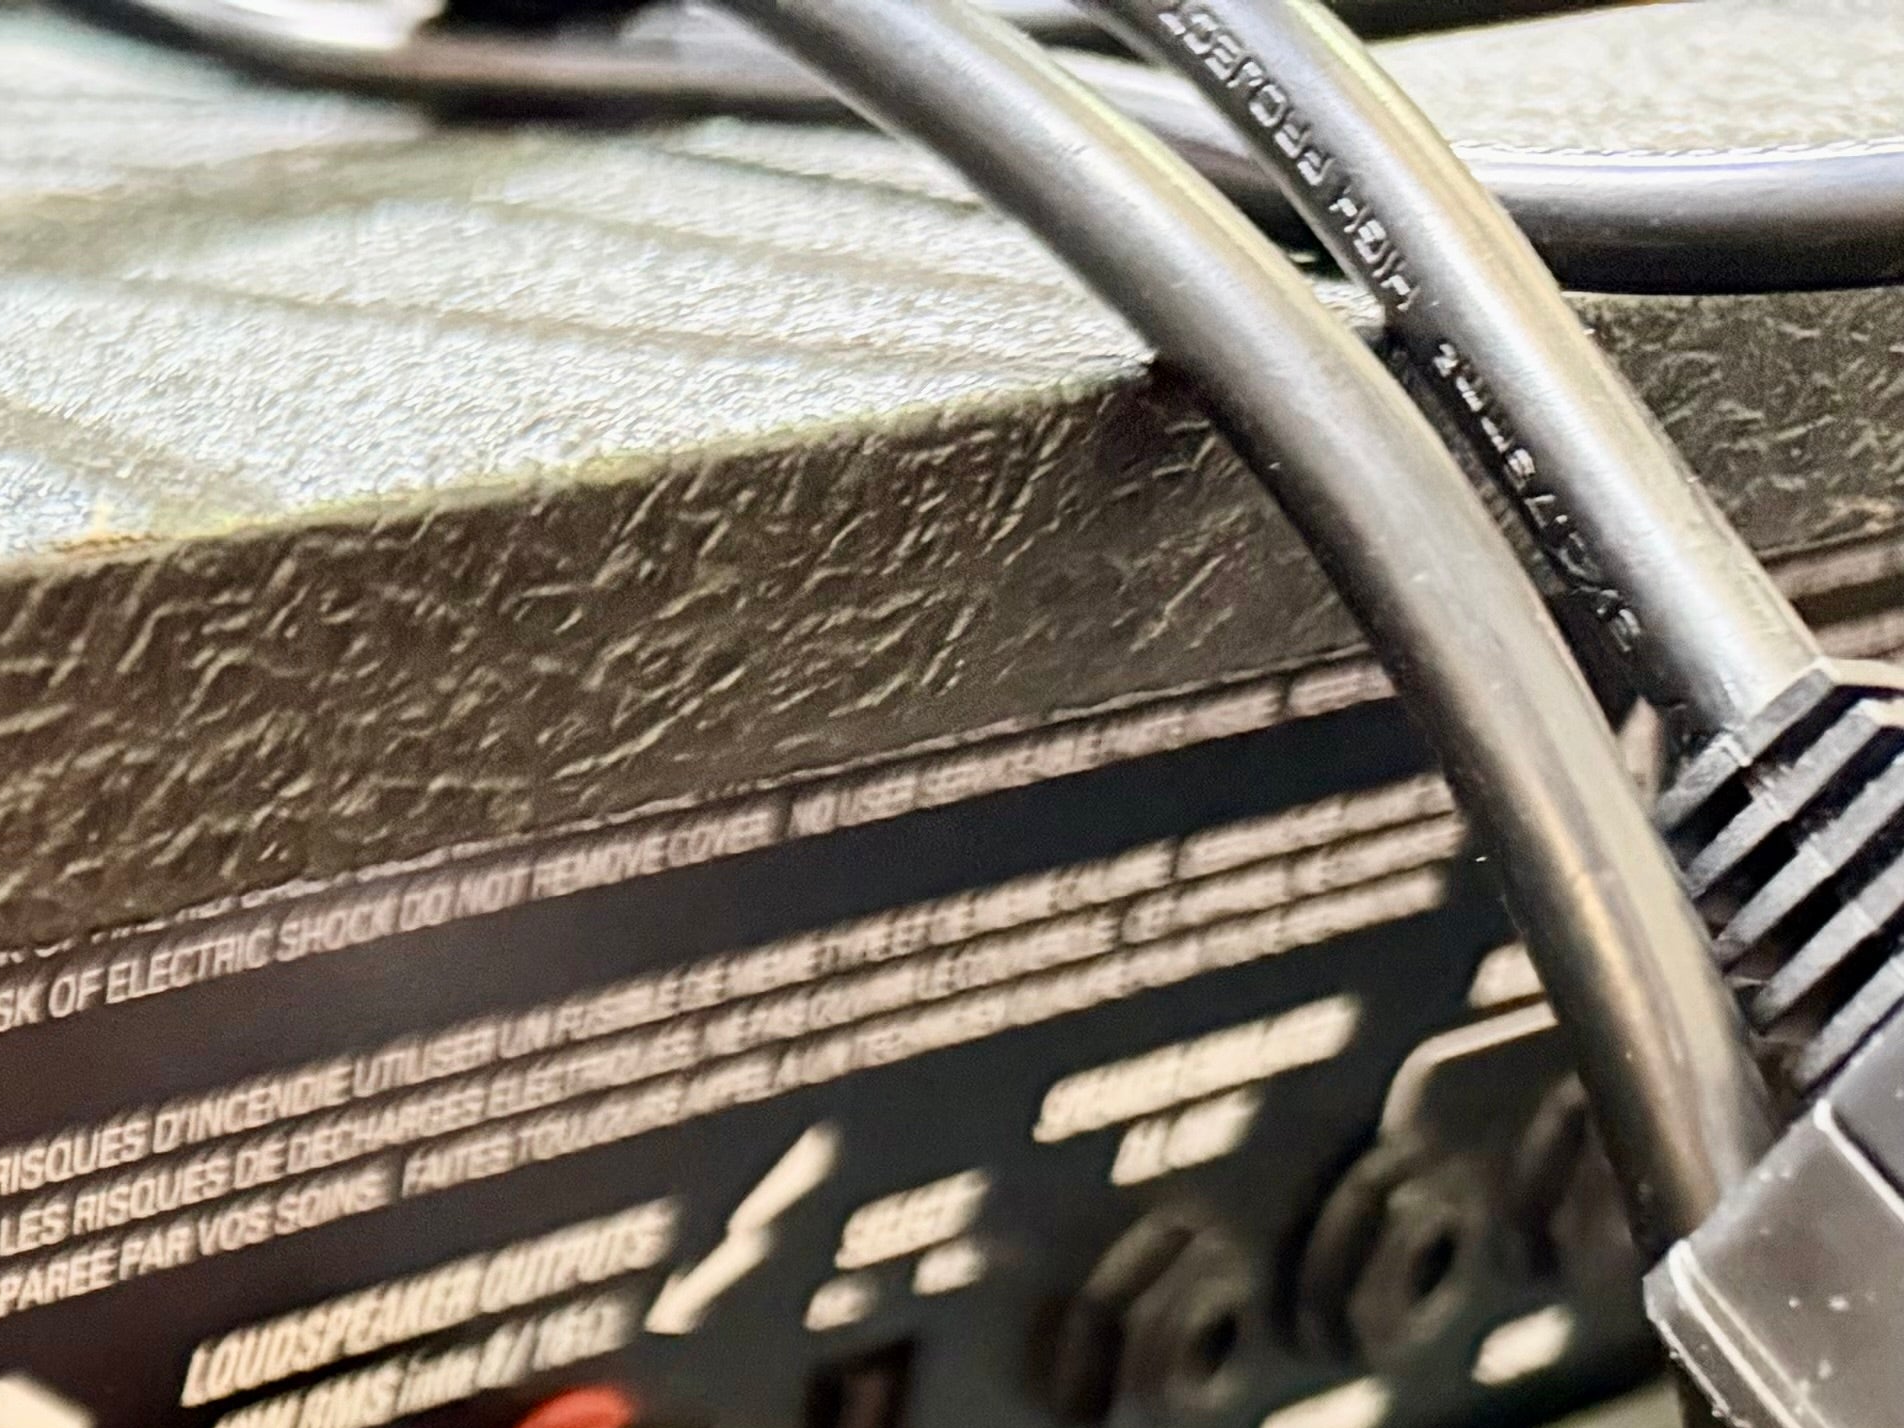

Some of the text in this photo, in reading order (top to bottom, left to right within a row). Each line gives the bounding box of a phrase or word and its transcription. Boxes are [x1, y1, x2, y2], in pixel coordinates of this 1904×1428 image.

[48, 965, 103, 1019] OF
[104, 921, 277, 1005] ELECTRIC
[274, 897, 394, 963] SHOCK
[396, 878, 458, 933] DO
[456, 858, 532, 917] NOT
[72, 1148, 234, 1237] RISQUES
[233, 1133, 289, 1191] DE
[287, 1079, 487, 1174] DECHARGES
[152, 1056, 353, 1155] D'INCENDIE
[118, 1215, 195, 1283] PAR
[196, 1194, 277, 1257] VOS
[400, 1133, 518, 1199] FAITES
[181, 1253, 486, 1408] LOUDSPEAKER
[478, 1193, 682, 1315] OUTPUTS
